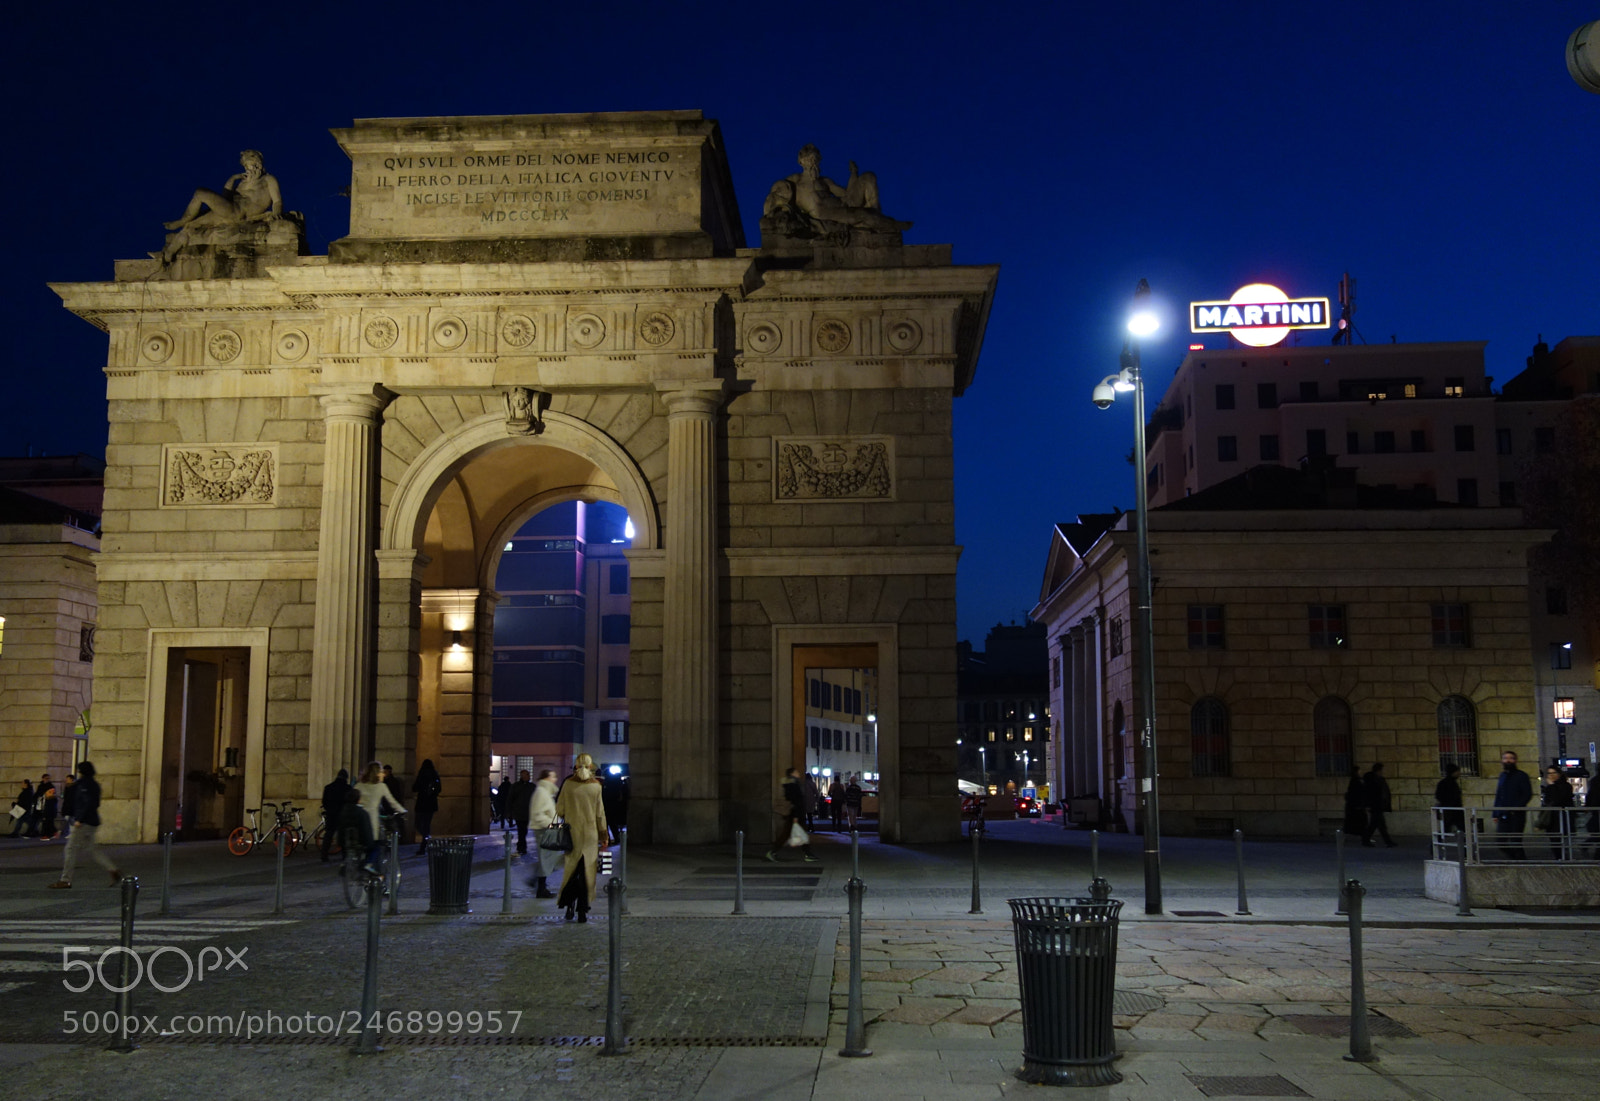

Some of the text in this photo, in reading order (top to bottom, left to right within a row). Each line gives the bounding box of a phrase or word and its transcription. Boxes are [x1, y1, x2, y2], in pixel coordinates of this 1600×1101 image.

[384, 152, 670, 171] QVI SVLL ORME DEL NOME NEMICO
[377, 170, 674, 187] IL FERRO DELLA ITALICA GIOVENTV
[407, 189, 649, 205] INCISE LE VITTORIE COMENSI
[481, 209, 569, 222] MDCCCLIX
[1199, 303, 1321, 327] MARTINI
